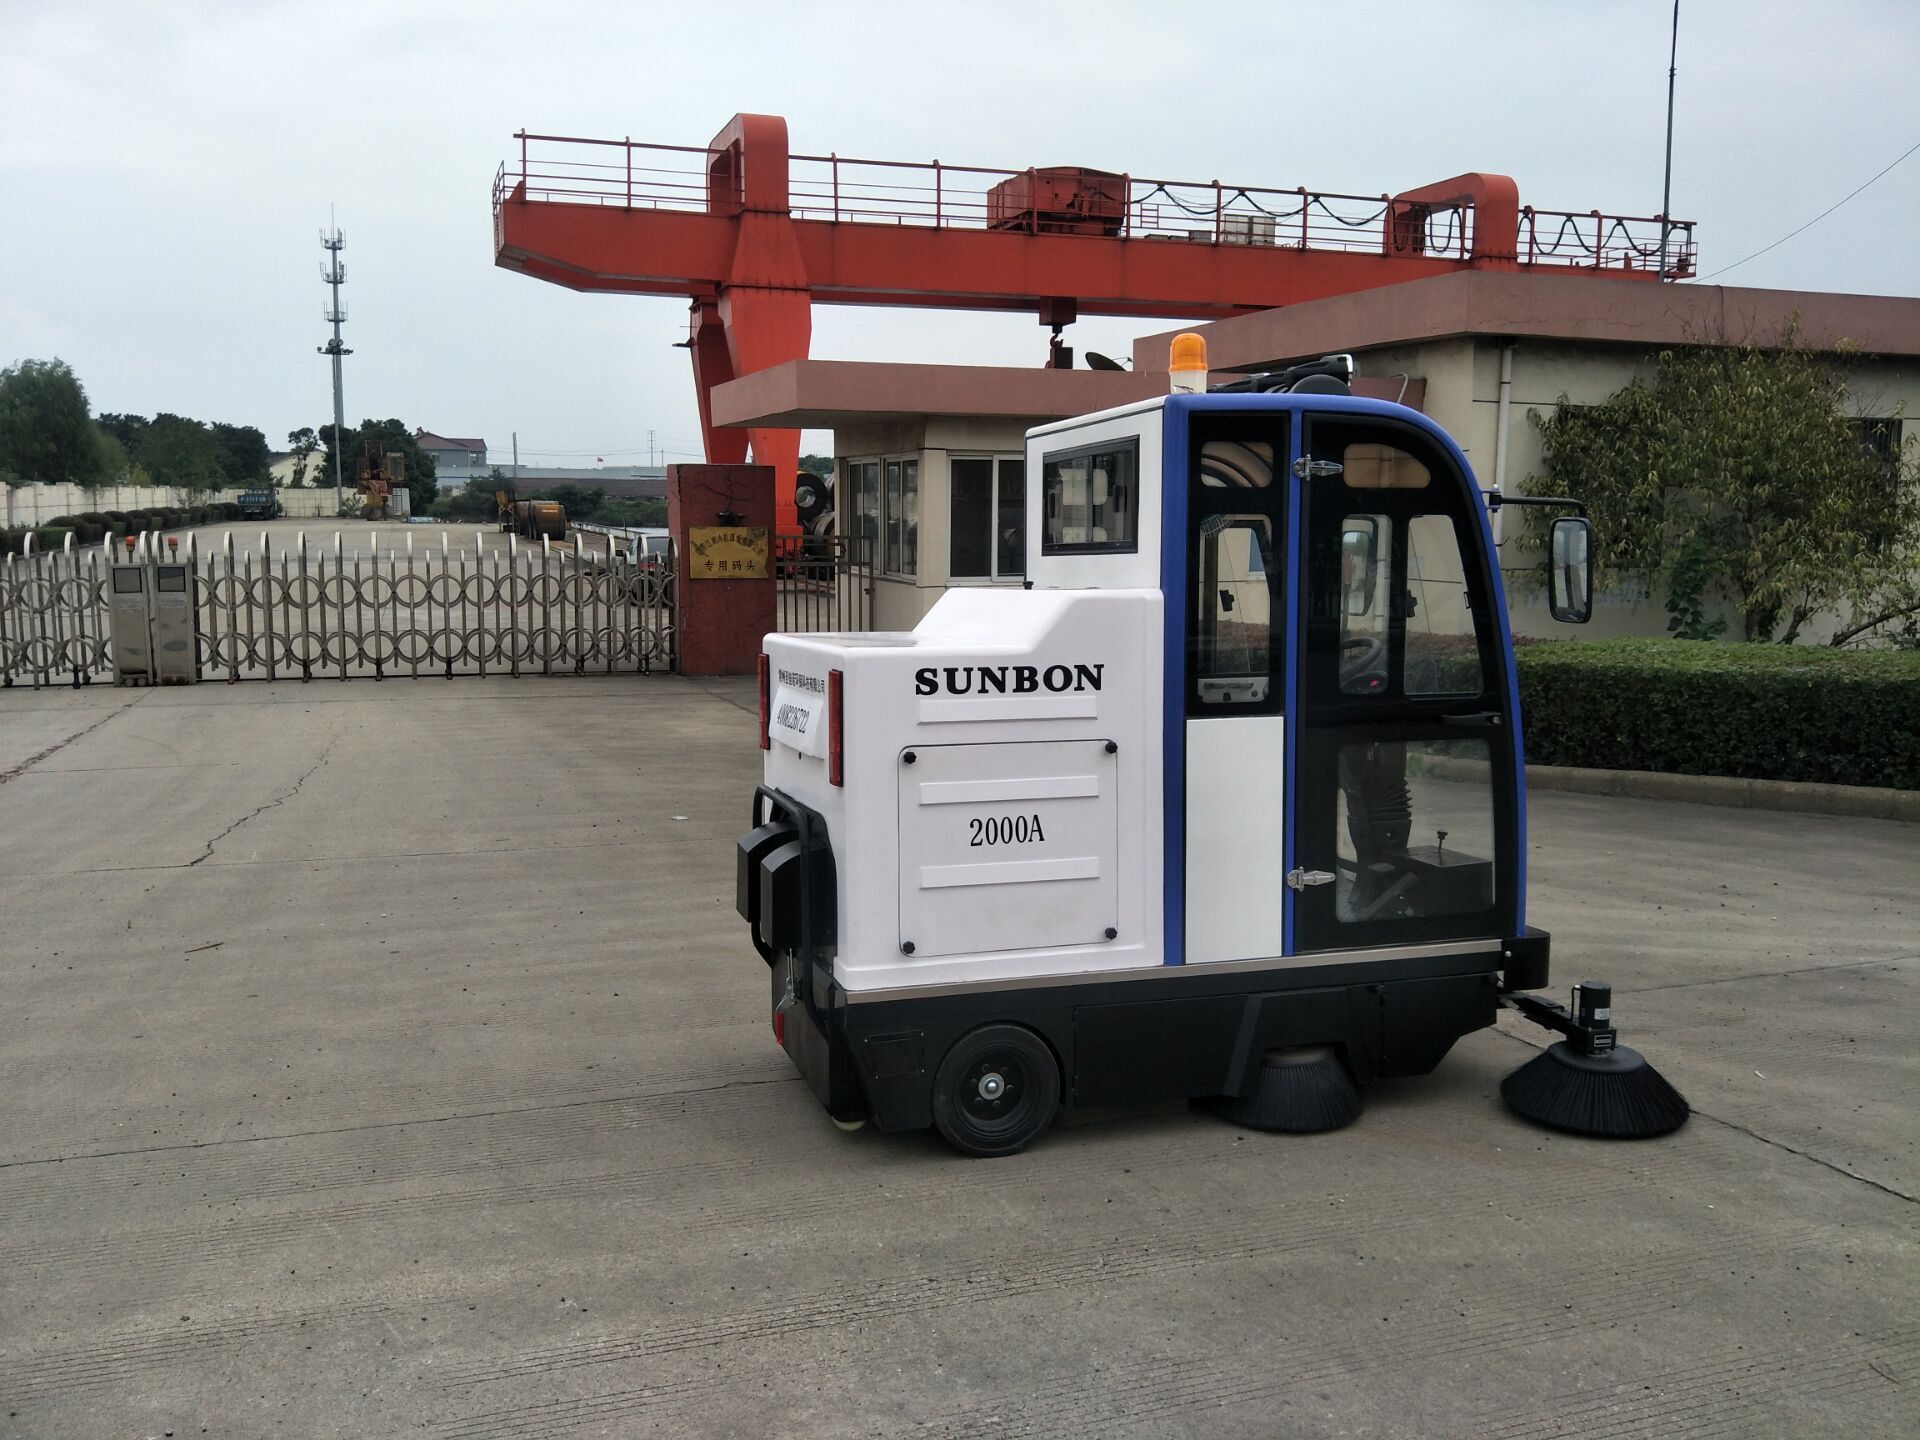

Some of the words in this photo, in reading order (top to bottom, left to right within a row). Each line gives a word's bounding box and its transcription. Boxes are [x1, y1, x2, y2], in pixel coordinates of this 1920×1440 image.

[704, 559, 756, 571] 专用码头
[915, 664, 1104, 695] SUNBON
[970, 814, 1045, 847] 2000A
